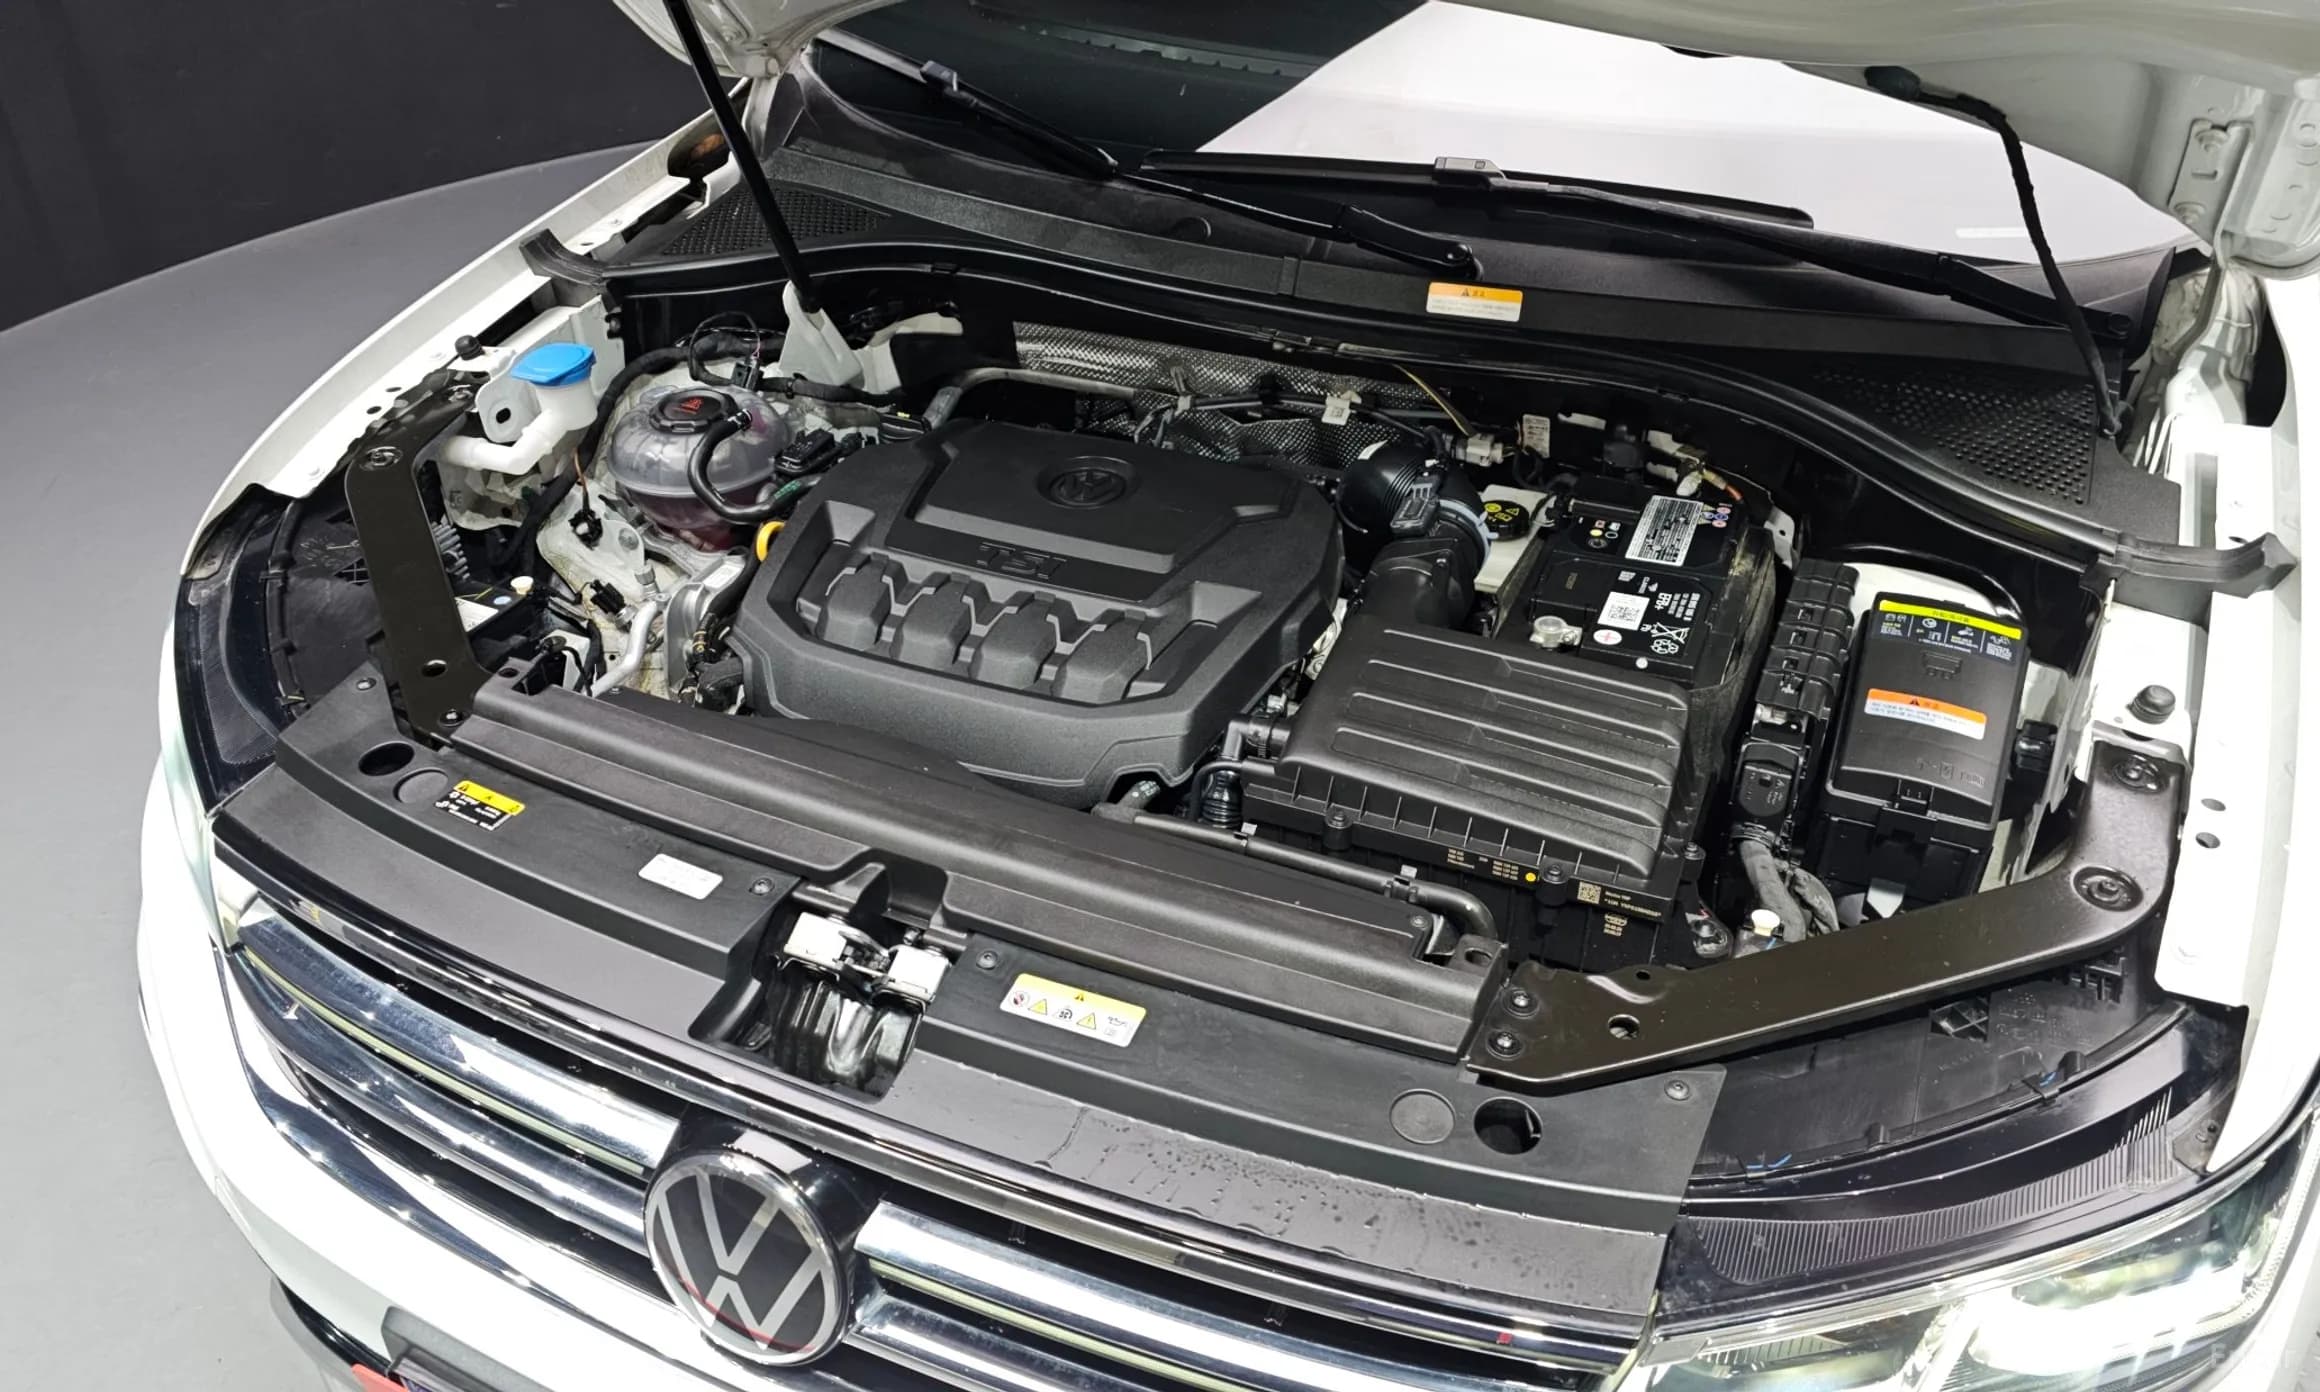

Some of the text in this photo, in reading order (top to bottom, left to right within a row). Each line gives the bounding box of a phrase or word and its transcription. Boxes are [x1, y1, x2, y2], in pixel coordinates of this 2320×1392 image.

[1050, 468, 1125, 504] VW
[976, 541, 1068, 580] TSI
[648, 1158, 840, 1362] VW
